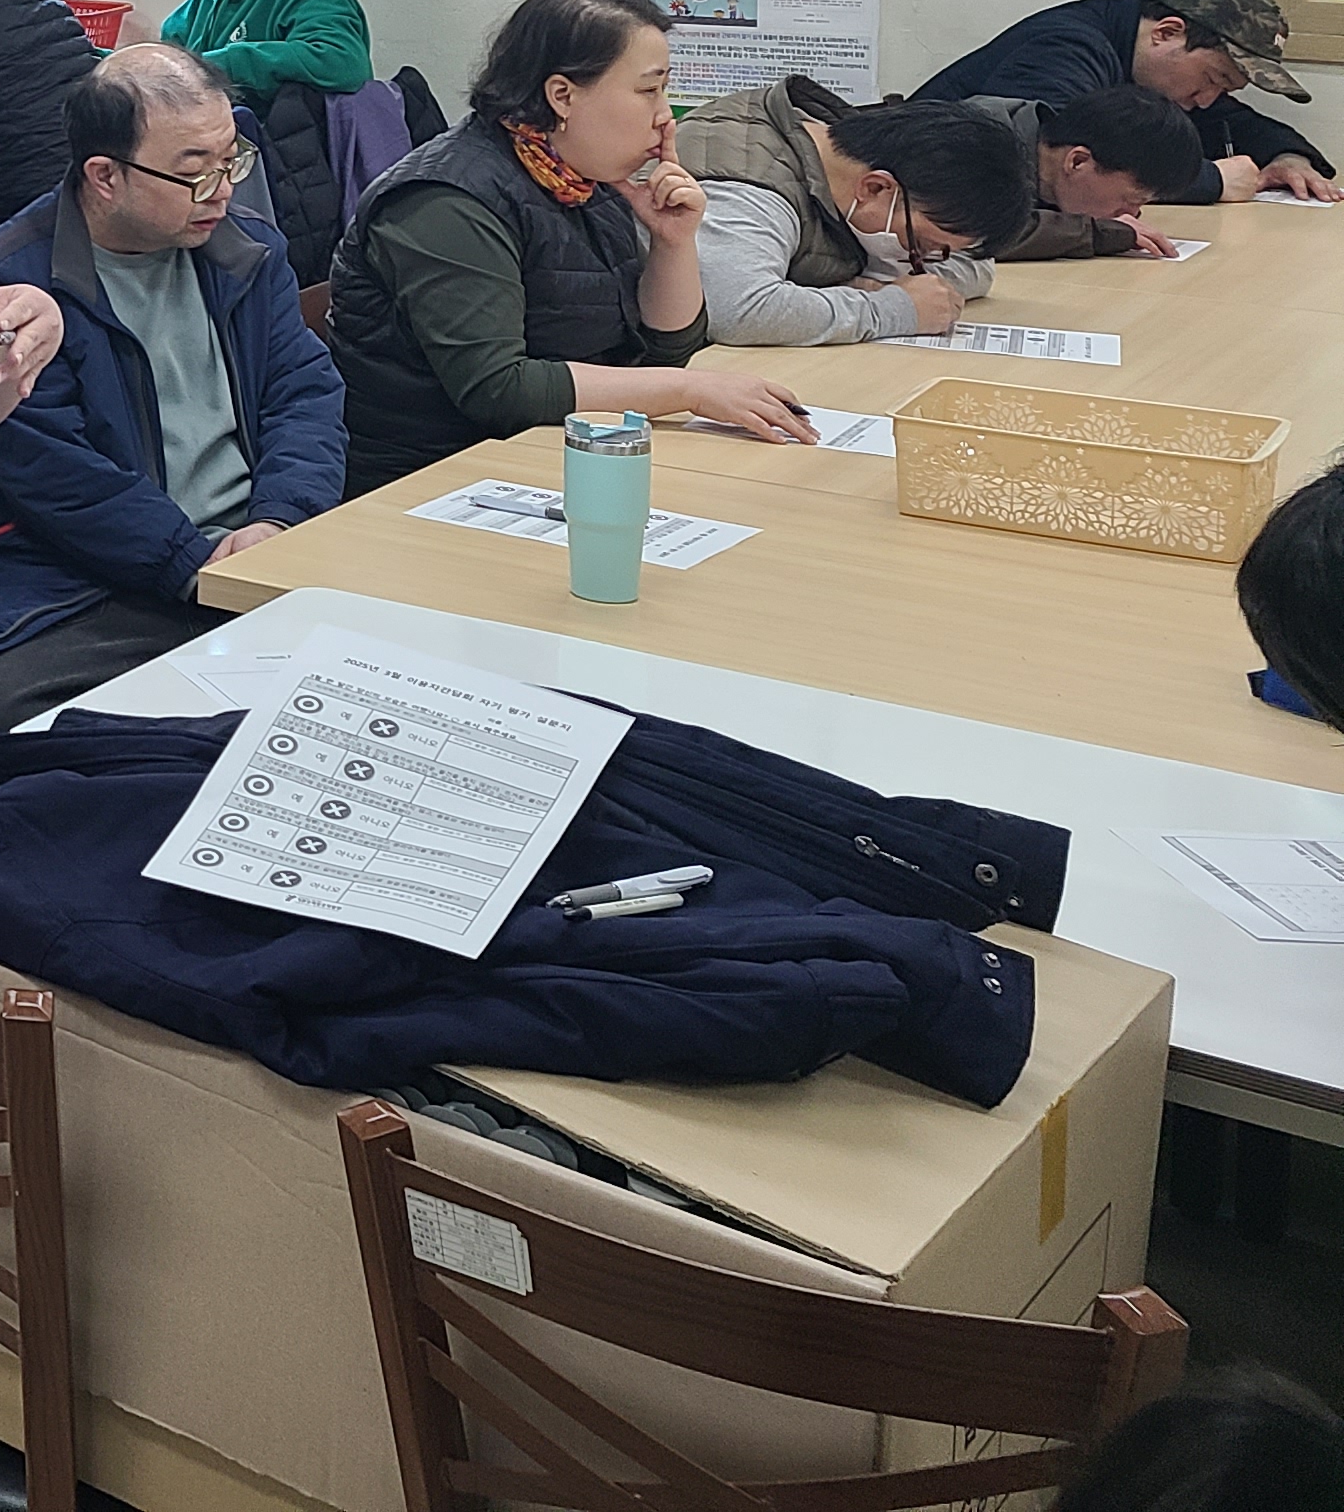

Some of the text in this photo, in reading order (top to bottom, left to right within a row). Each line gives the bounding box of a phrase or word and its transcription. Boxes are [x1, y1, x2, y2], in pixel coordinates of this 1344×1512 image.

[343, 656, 380, 674] 2025년
[407, 733, 439, 748] 아니오
[383, 773, 414, 791] 아니오
[359, 814, 390, 830] 아니오
[335, 847, 367, 862] 아니오
[309, 881, 341, 895] 아니오
